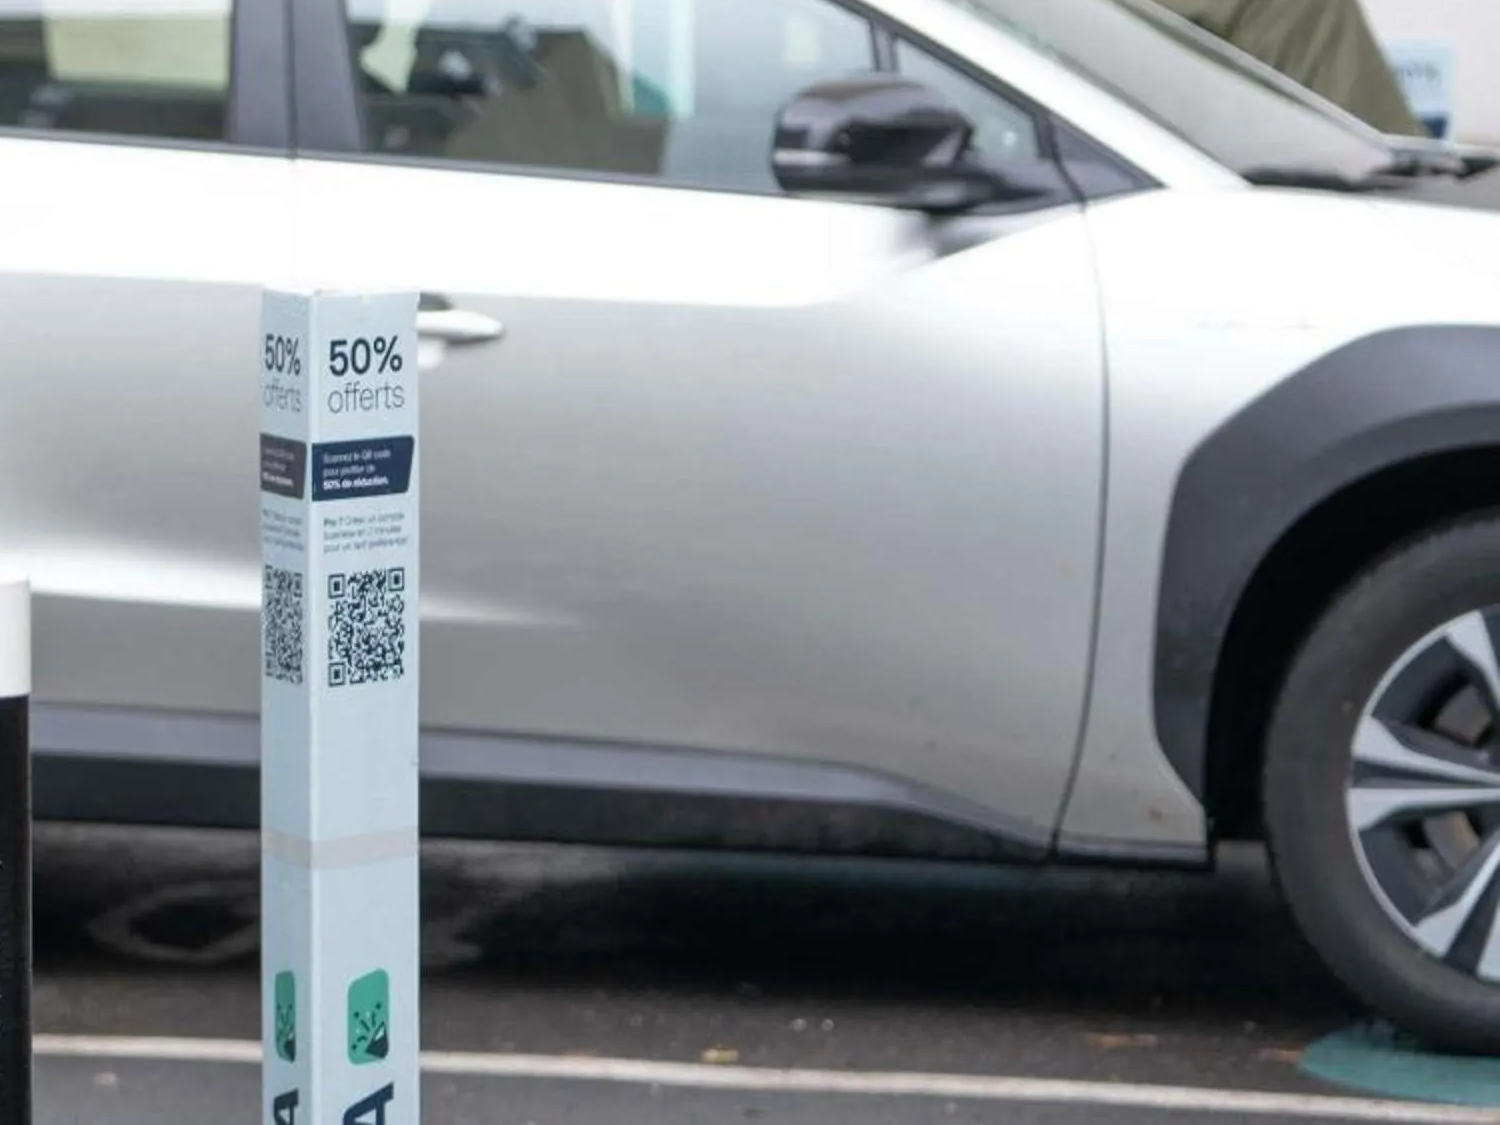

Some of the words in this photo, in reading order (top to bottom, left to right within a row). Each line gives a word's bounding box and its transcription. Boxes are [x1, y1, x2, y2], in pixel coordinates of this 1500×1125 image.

[264, 333, 301, 376] 50%
[328, 335, 403, 377] 50%
[327, 381, 406, 415] offerts
